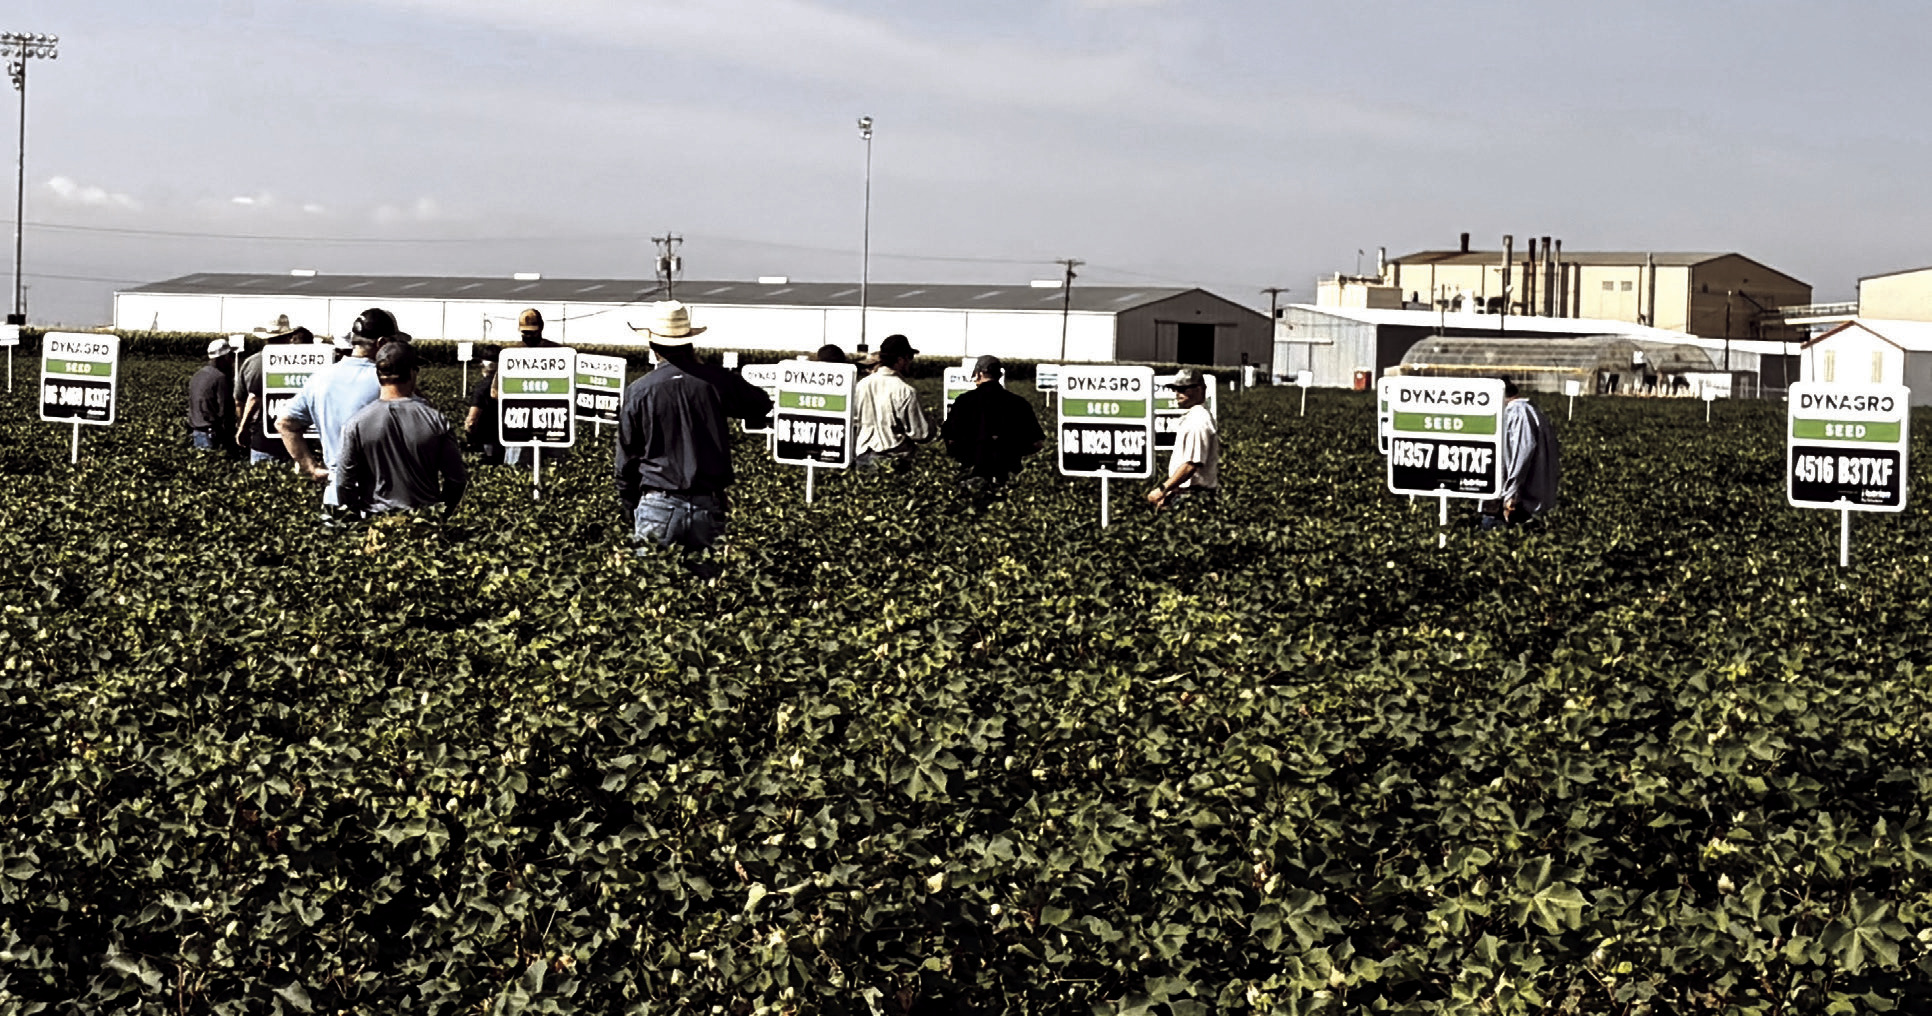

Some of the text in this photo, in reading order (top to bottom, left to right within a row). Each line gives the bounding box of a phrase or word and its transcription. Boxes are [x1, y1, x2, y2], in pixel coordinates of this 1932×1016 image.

[51, 340, 109, 356] DYNAGRO
[269, 354, 325, 366] DYNAGRO
[506, 358, 566, 370] DYNAGRO
[65, 362, 92, 374] SEED
[784, 369, 845, 387] DYNAGRO
[1067, 376, 1141, 392] DYNAGRO
[522, 380, 549, 392] SEED
[798, 395, 826, 408] SEED
[1400, 388, 1490, 406] DYNAGRO
[1801, 393, 1894, 412] DYNAGRO
[1087, 402, 1120, 415] SEED
[1424, 416, 1464, 431] SEED
[1825, 423, 1866, 438] SEED
[1393, 439, 1493, 474] H357 B3TXF
[1794, 454, 1894, 486] 4516 B3TXF
